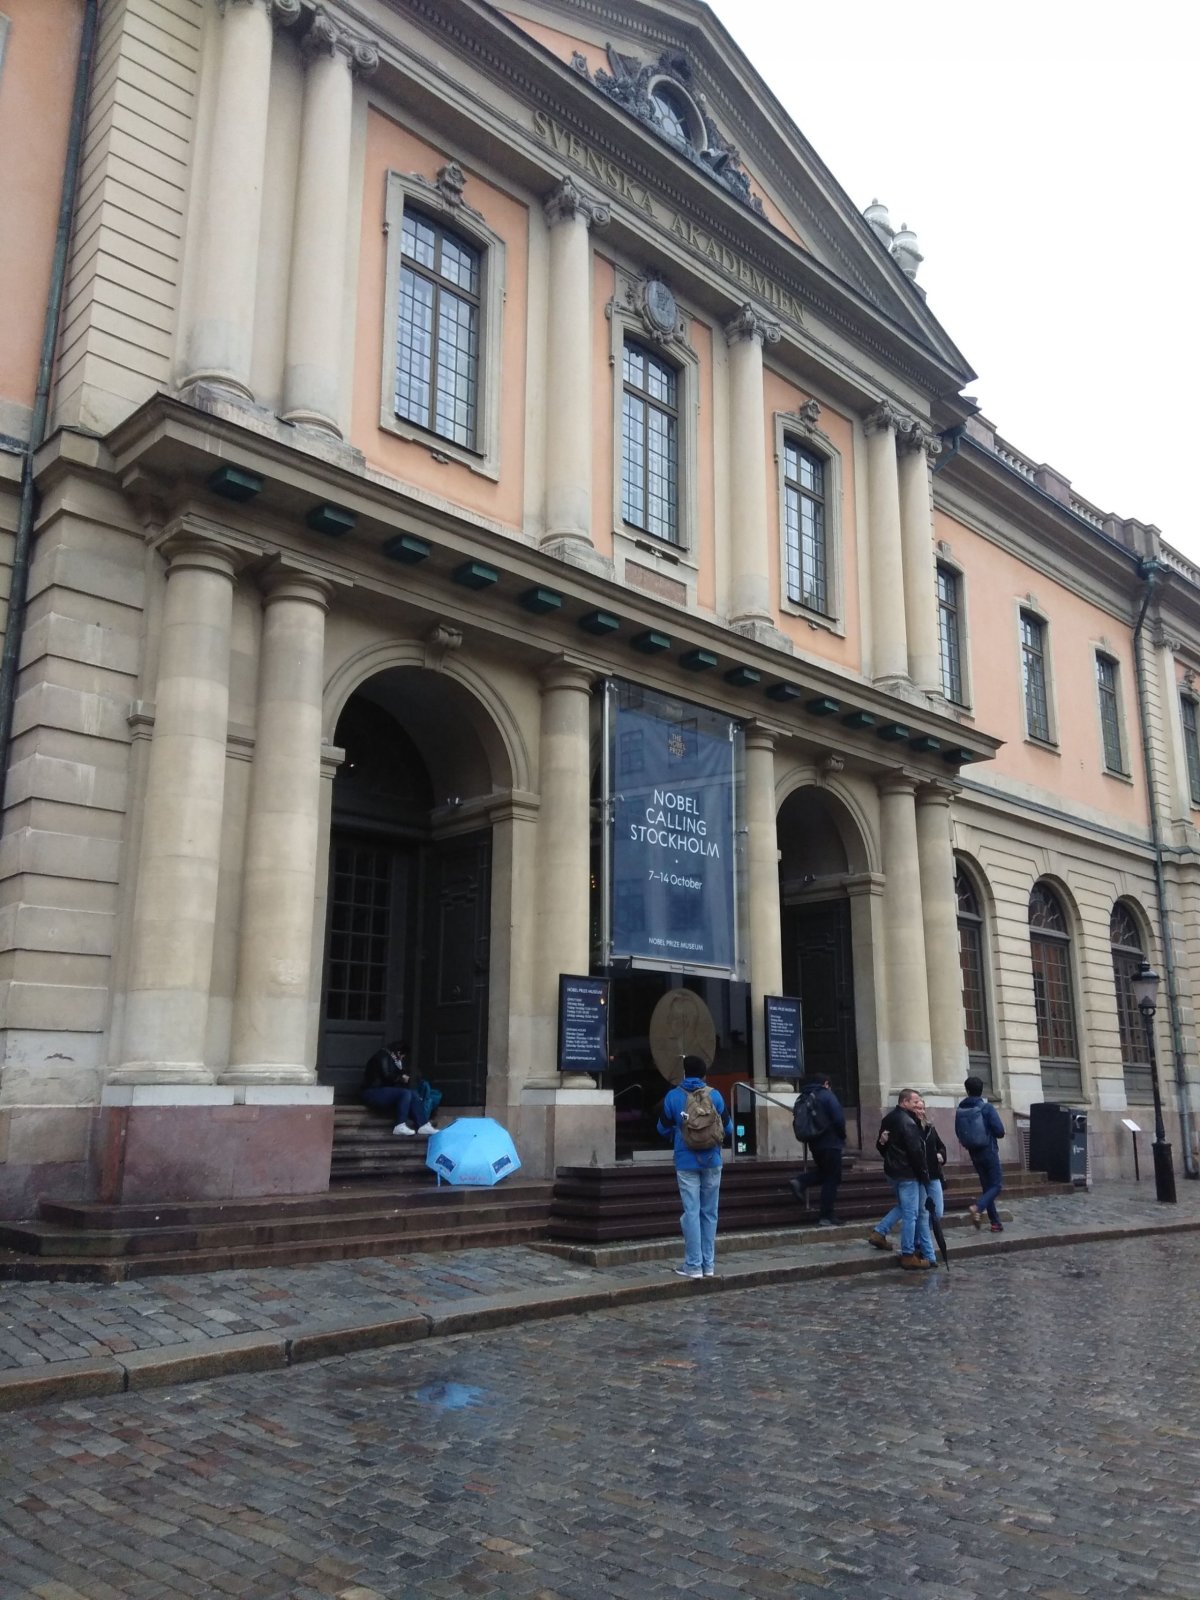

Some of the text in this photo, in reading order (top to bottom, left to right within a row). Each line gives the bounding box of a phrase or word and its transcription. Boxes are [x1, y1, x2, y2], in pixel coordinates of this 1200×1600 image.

[534, 110, 805, 324] SVENSKA AKADEMIEN
[654, 788, 700, 815] NOBEL
[646, 808, 707, 836] CALLING
[630, 824, 720, 859] STOCKHOLM
[670, 874, 703, 890] October
[648, 937, 704, 951] NOBEL PRIZE MUSEUM
